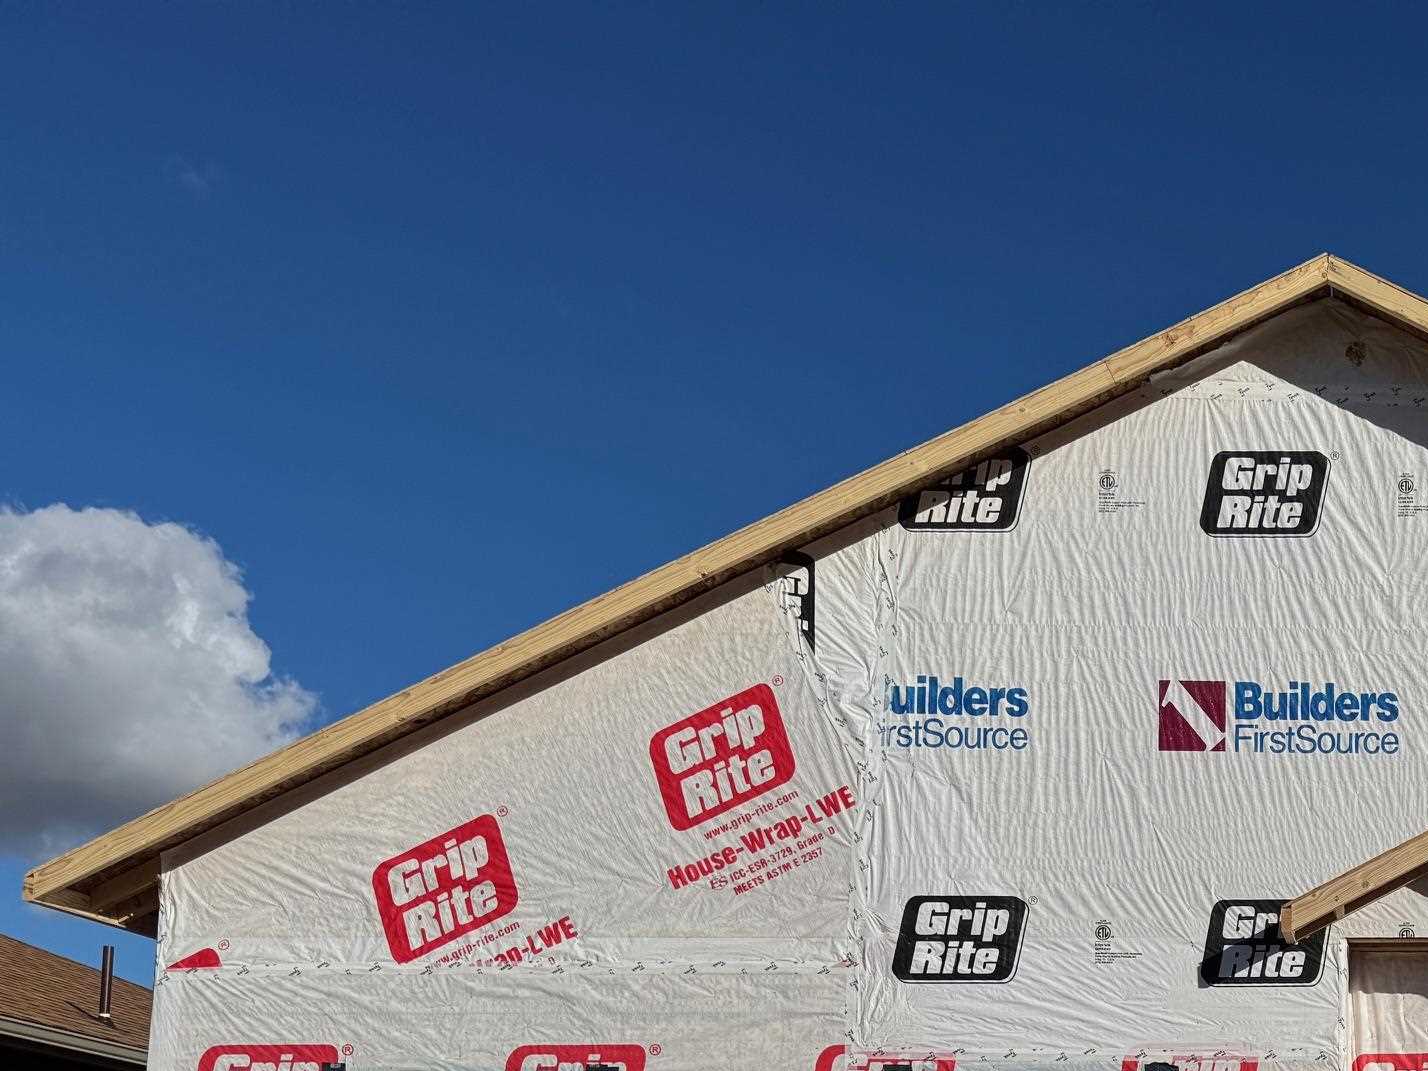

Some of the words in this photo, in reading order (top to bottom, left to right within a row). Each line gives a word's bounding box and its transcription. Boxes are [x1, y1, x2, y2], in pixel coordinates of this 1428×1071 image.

[1222, 457, 1313, 496] Grip
[915, 490, 1003, 523] Rite
[1216, 496, 1303, 528] Rite
[892, 675, 1029, 717] uilders
[1235, 681, 1399, 721] Builders
[665, 704, 766, 775] Grip
[1235, 725, 1399, 754] FirstSource
[680, 749, 776, 819] Rite
[704, 790, 800, 840] www.grip-rite.com
[666, 785, 856, 890] House-Wrap-LWE
[797, 832, 824, 850] Grade
[388, 835, 489, 906] Grip
[733, 877, 765, 896] MEETS
[766, 863, 792, 882] ASTM
[801, 847, 824, 865] 2357
[403, 880, 499, 950] Rite
[915, 902, 1010, 942] Grip
[1222, 906, 1280, 939] Gr
[910, 941, 999, 974] Rite
[1219, 944, 1306, 978] Rite
